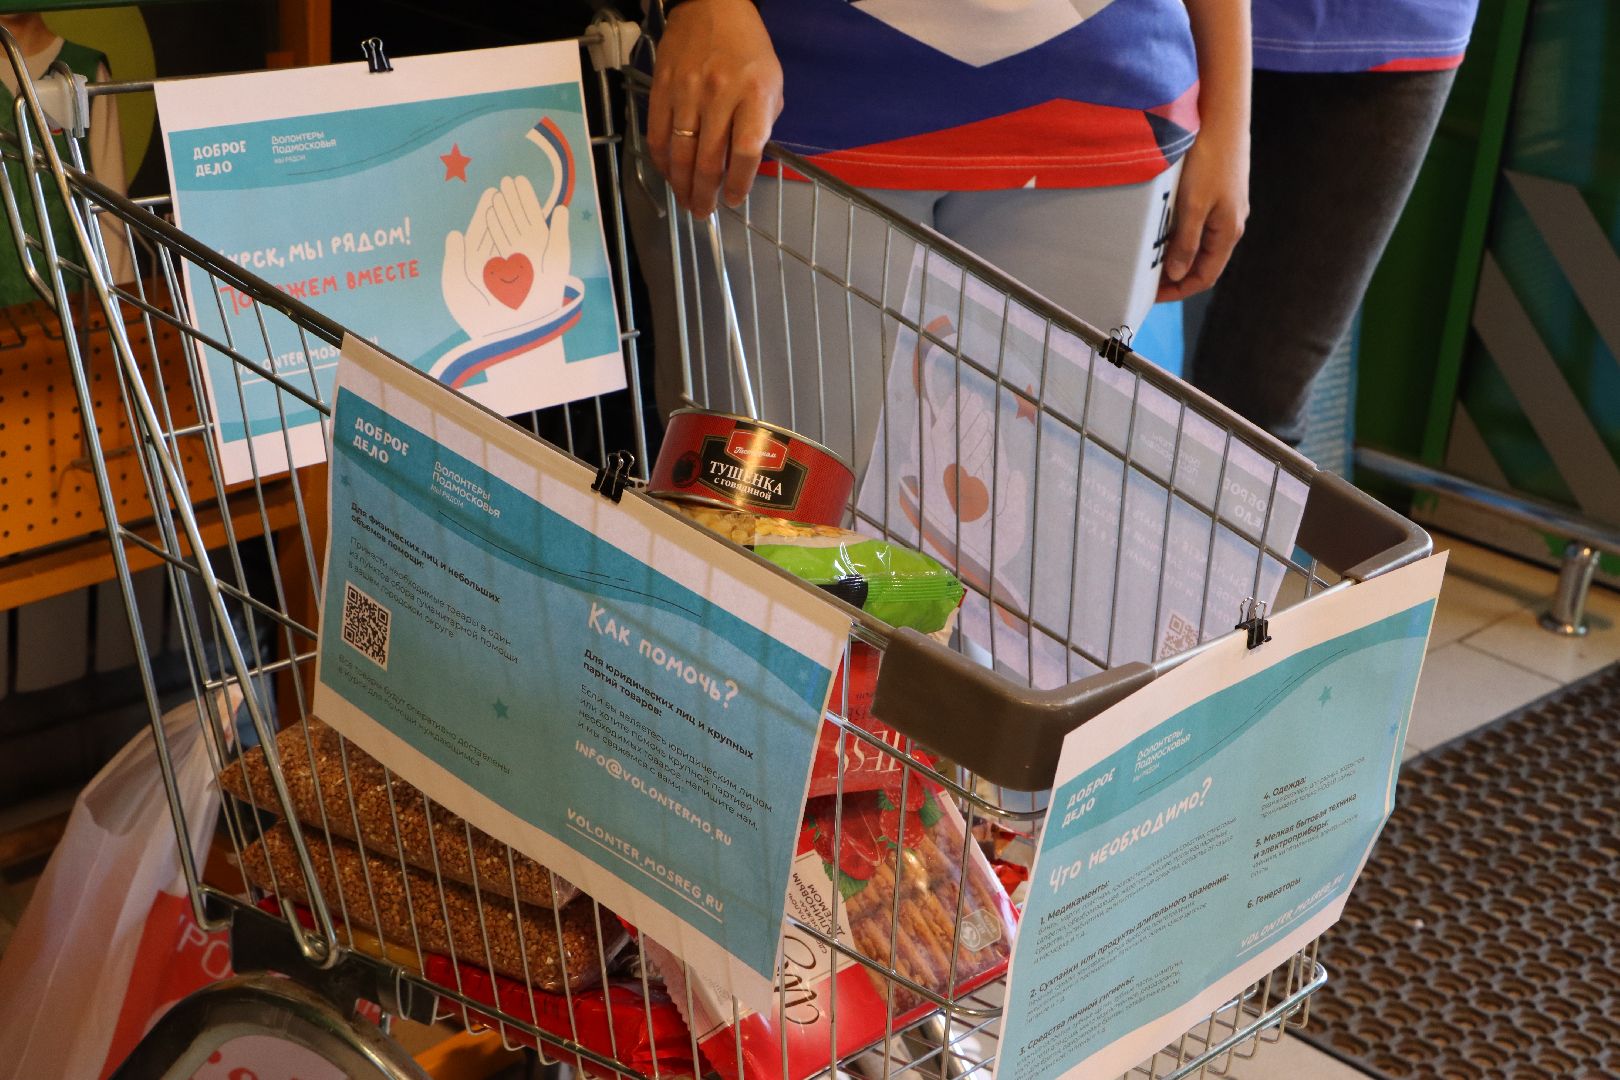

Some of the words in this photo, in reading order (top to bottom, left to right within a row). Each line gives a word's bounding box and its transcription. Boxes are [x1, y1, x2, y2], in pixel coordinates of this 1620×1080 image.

[193, 140, 246, 160] ДОБРОЕ
[195, 160, 232, 177] ДЕЛО
[289, 240, 323, 262] МЫ
[331, 217, 412, 254] РЯДОМ!
[346, 259, 420, 290] ВМЕСТЕ
[353, 435, 389, 464] ДЕЛО
[355, 417, 410, 456] ДОБРОЕ
[720, 479, 772, 501] говядиной
[351, 502, 368, 517] Для
[369, 513, 420, 553] физических
[421, 551, 439, 568] лиц
[440, 562, 447, 571] и
[448, 567, 500, 604] небольших
[583, 661, 618, 689] партий
[619, 685, 663, 717] товаров:
[584, 649, 604, 666] Для
[606, 661, 674, 711] юридических
[676, 706, 695, 726] лиц
[698, 720, 705, 731] и
[707, 724, 754, 761] крупных
[579, 698, 599, 714] или
[600, 710, 630, 733] хотите
[668, 754, 709, 787] крупной
[711, 783, 753, 812] партией
[580, 683, 603, 704] Если
[605, 701, 618, 714] вы
[619, 710, 667, 746] являетесь
[668, 742, 737, 791] юридическим
[575, 740, 732, 846] INFO@VOLONTERMO.RU
[1067, 767, 1117, 809] ДОБРОЕ
[1273, 775, 1308, 797] Одежда:
[1050, 861, 1081, 894] ЧТО
[1088, 776, 1213, 870] НЕОБХОДИМО?
[1062, 797, 1096, 829] ДЕЛО
[1264, 825, 1294, 844] Мелкая
[1328, 793, 1357, 814] техника
[567, 807, 723, 913] VOLONTER.MOSREG.RU
[1253, 851, 1260, 860] и
[793, 873, 834, 936] АЛИНОВЫМ
[807, 884, 846, 936] ДЕМОМ
[1048, 880, 1111, 922] Медикаменты:
[1247, 899, 1255, 909] 6.
[1256, 877, 1301, 904] Генераторы
[1030, 987, 1038, 998] 2.
[1039, 962, 1079, 993] Сухпайки
[1080, 950, 1097, 967] или
[1097, 927, 1136, 956] продукты
[1136, 895, 1187, 932] длительного
[1188, 873, 1230, 900] хранения:
[1028, 1020, 1066, 1050] Средства
[1067, 996, 1098, 1022] личной
